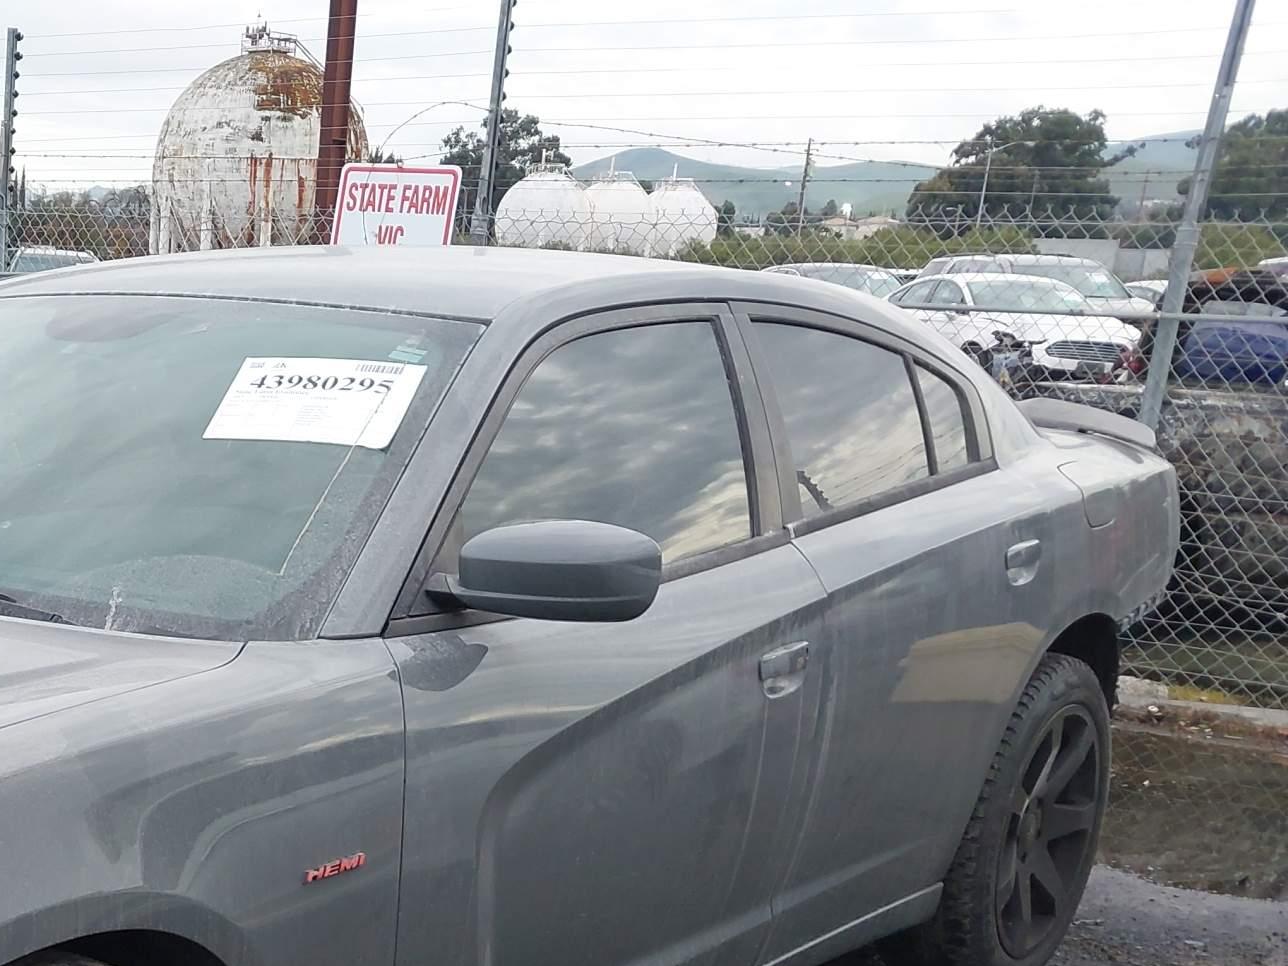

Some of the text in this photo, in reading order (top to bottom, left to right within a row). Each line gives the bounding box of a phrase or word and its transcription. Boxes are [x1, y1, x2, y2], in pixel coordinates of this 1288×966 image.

[346, 182, 449, 215] STATE FARM
[250, 374, 394, 394] 43980295
[303, 852, 367, 884] HEMI
